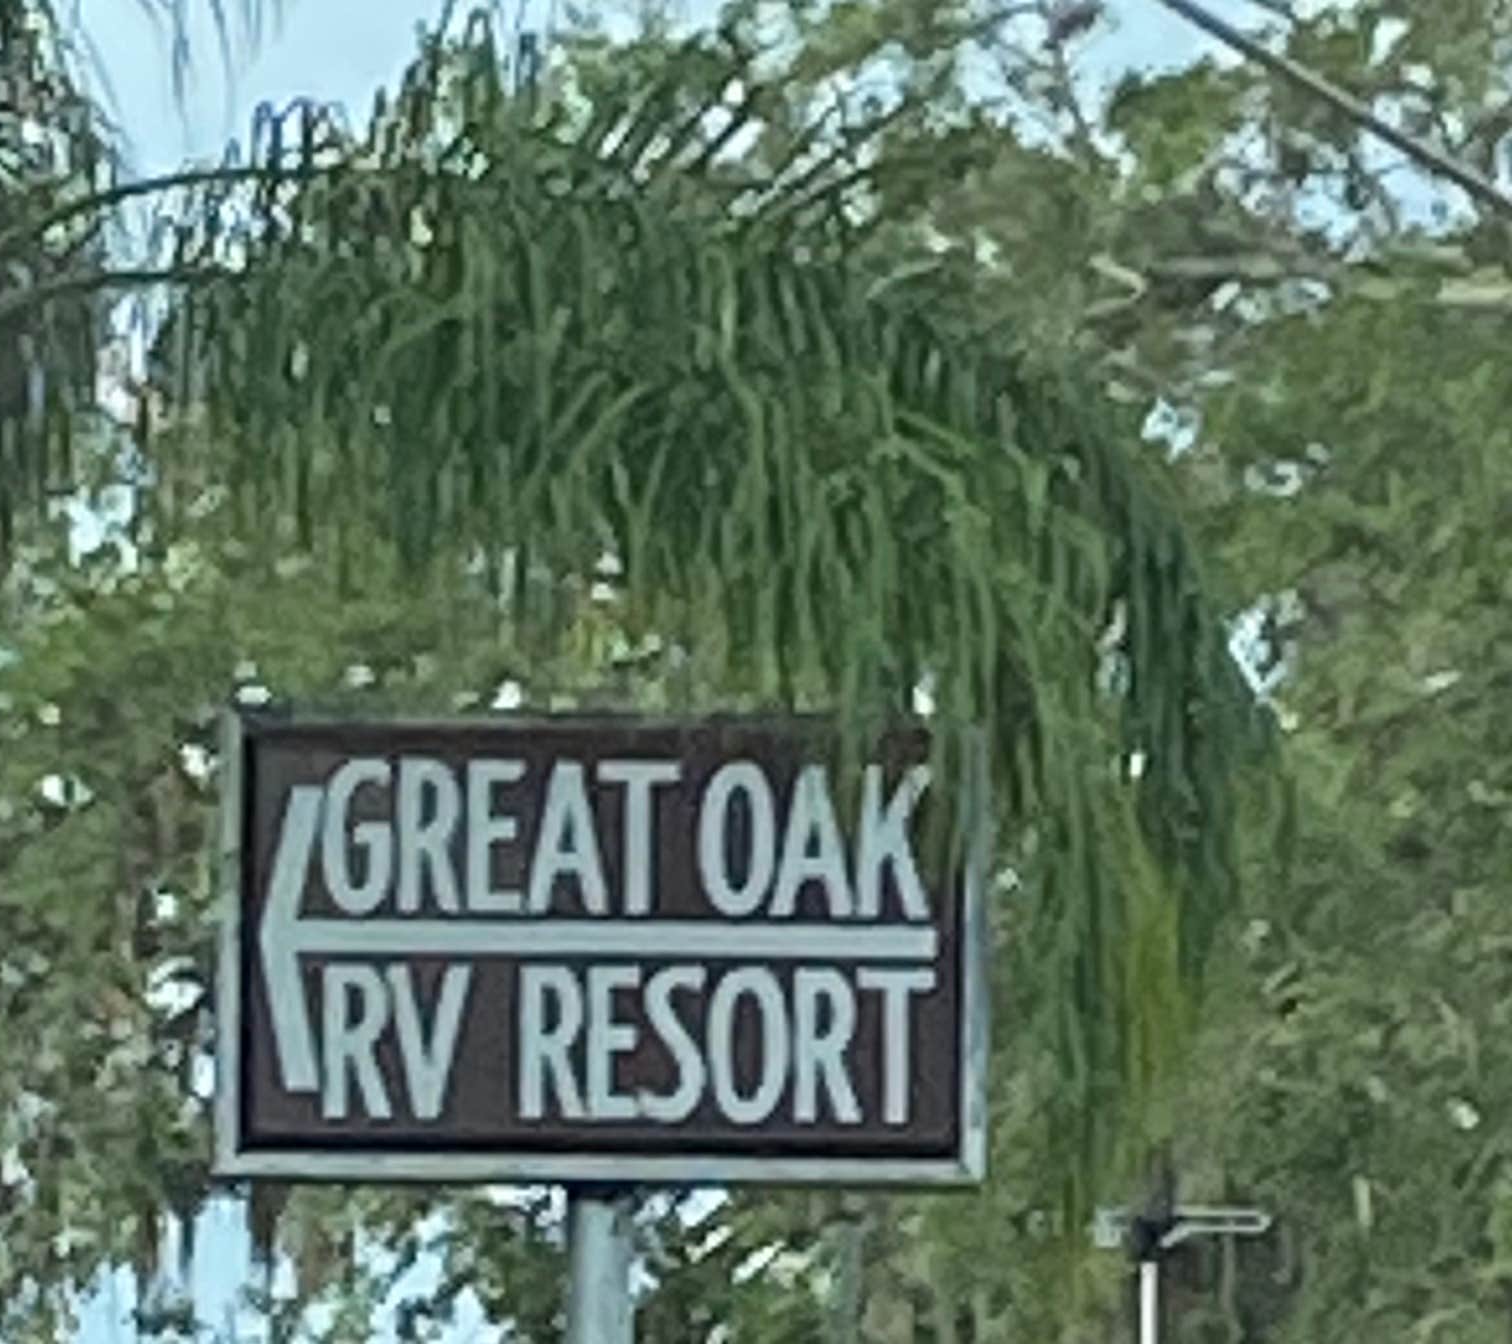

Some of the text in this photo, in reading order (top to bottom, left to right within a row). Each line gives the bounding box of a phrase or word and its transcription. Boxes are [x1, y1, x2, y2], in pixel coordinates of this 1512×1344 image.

[321, 757, 934, 921] GREAT OAK
[322, 964, 937, 1125] RV RESORT
